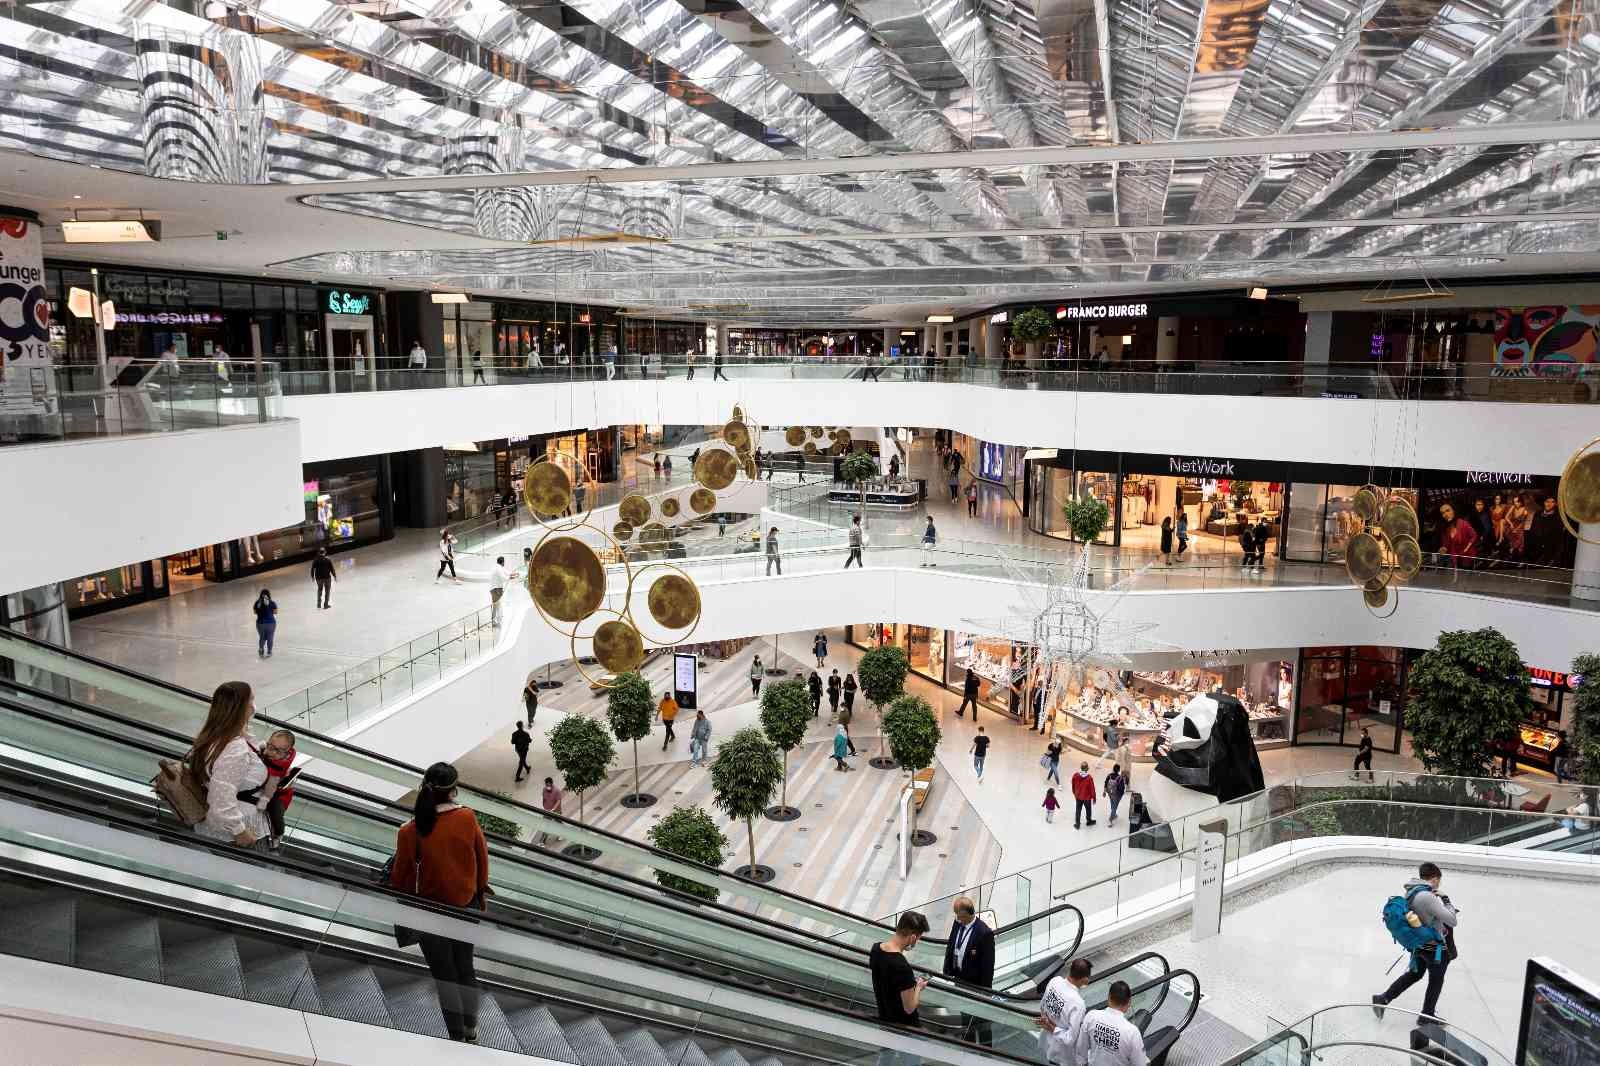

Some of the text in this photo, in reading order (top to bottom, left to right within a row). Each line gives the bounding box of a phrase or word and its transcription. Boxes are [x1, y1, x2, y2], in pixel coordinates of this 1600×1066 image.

[1067, 304, 1148, 318] FRANCO BURGER
[1169, 457, 1235, 476] NetWork
